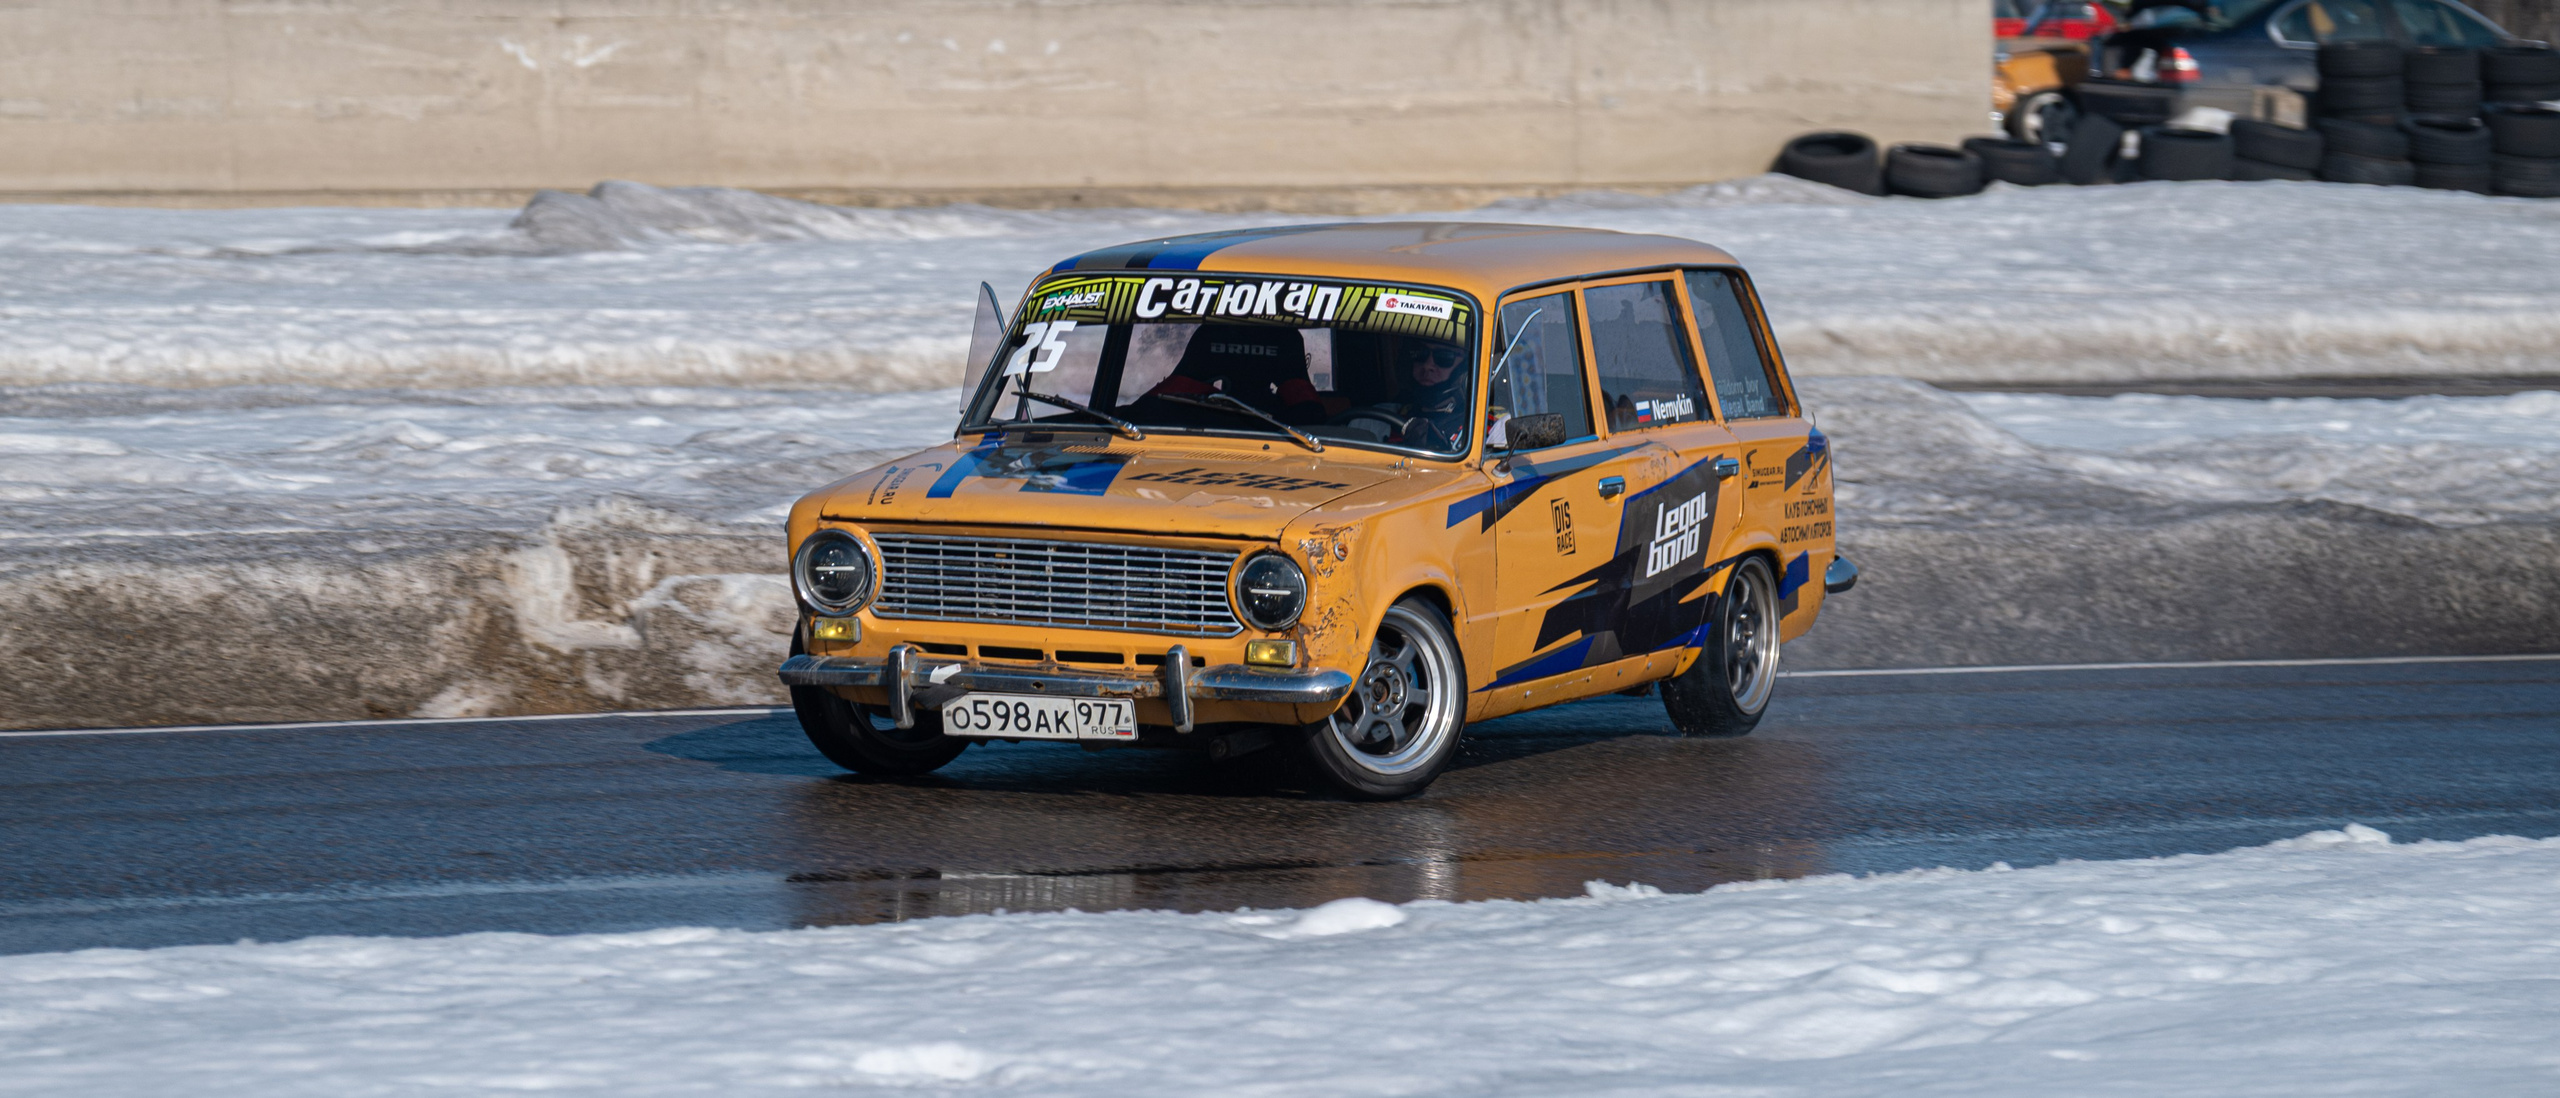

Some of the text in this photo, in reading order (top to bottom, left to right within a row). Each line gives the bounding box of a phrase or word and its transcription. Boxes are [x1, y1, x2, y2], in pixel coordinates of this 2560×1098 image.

[1041, 291, 1105, 311] EXHAUST
[1400, 301, 1443, 314] TAKAYAMA
[1002, 320, 1078, 377] 25
[1210, 342, 1279, 357] BRIDE
[1651, 393, 1694, 422] Nemykin
[1554, 501, 1571, 534] DIS
[1784, 501, 1800, 519] КЛУБ
[1556, 531, 1573, 553] RACE
[1077, 702, 1122, 727] 977
[1091, 725, 1115, 735] RUS
